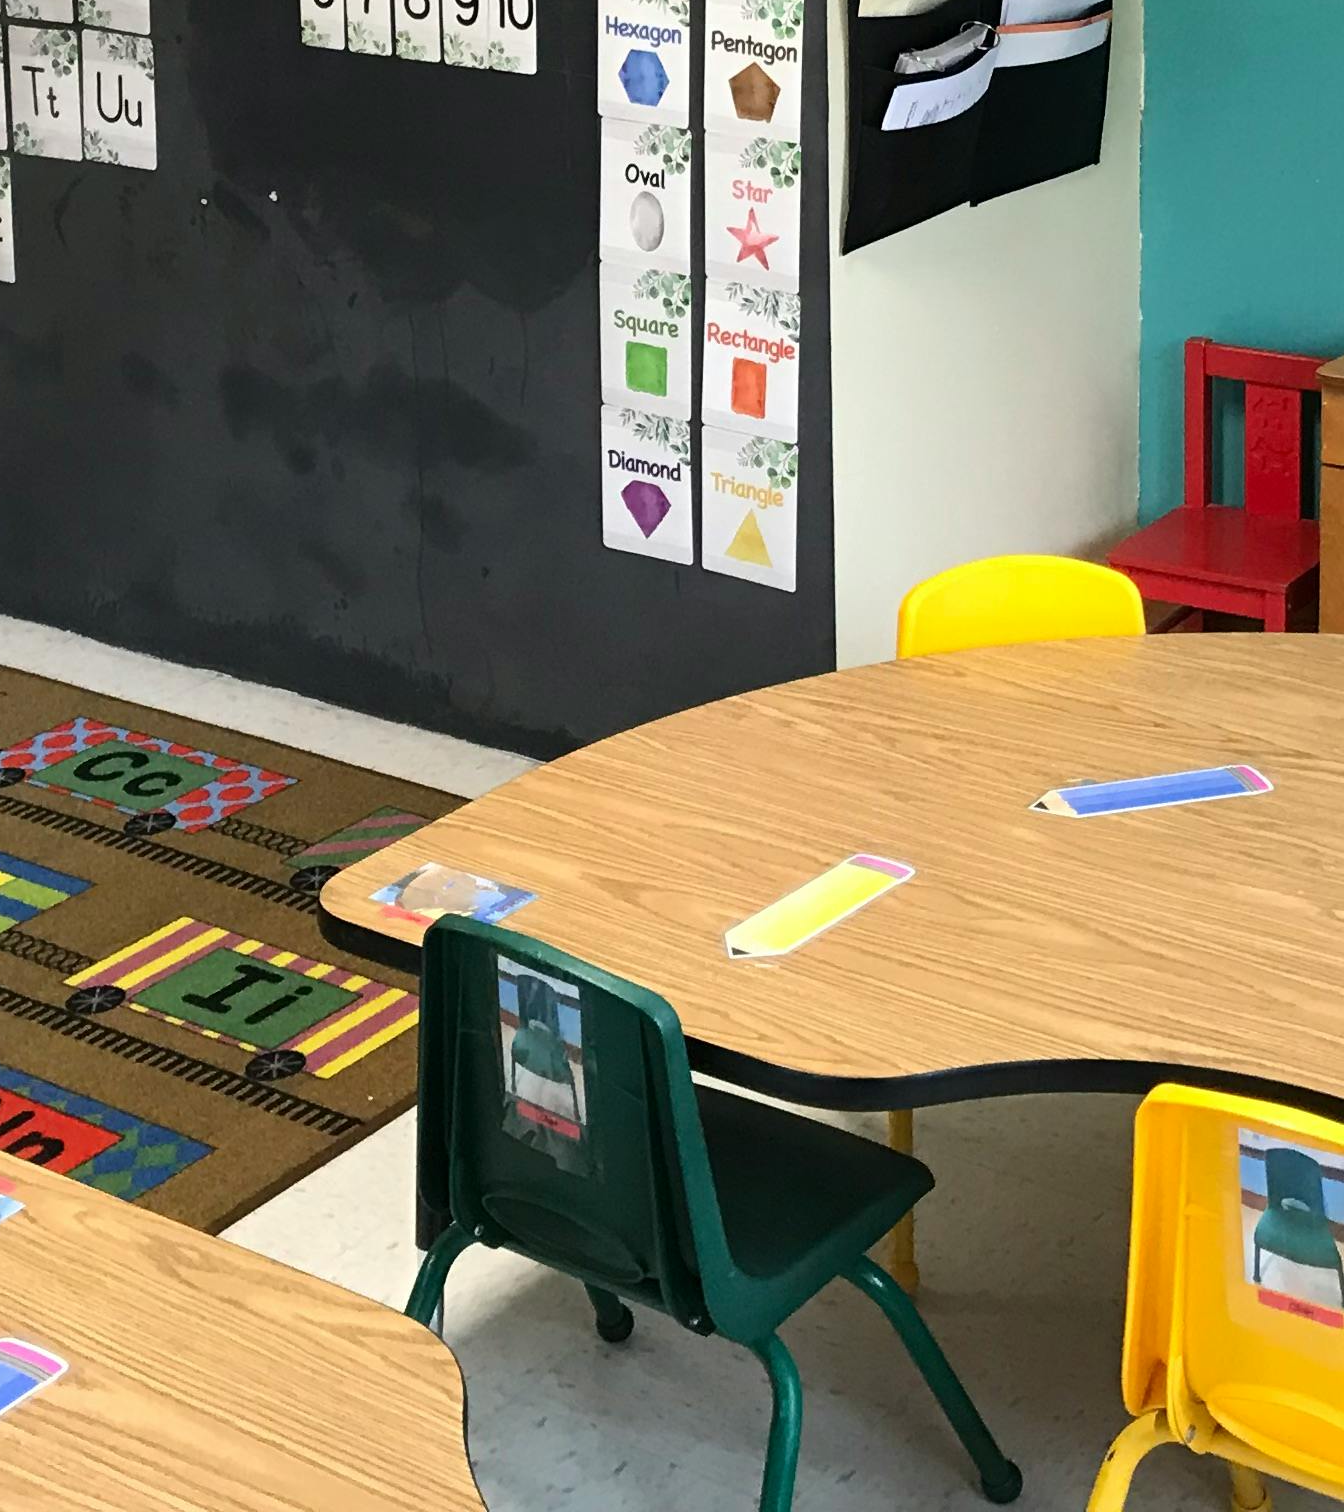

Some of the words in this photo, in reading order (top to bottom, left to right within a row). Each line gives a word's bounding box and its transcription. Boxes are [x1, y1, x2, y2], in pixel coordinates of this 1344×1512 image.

[606, 16, 682, 48] Hexagon
[712, 30, 797, 65] Pentagon
[22, 66, 59, 119] Tt
[97, 71, 142, 127] Uu
[625, 164, 666, 188] Oval
[732, 180, 773, 203] Star
[613, 310, 679, 341] Square
[707, 323, 795, 362] Rectangle
[608, 449, 681, 482] Diamond
[710, 471, 784, 509] Triangle
[71, 750, 184, 799] Cc
[182, 963, 312, 1027] Ii
